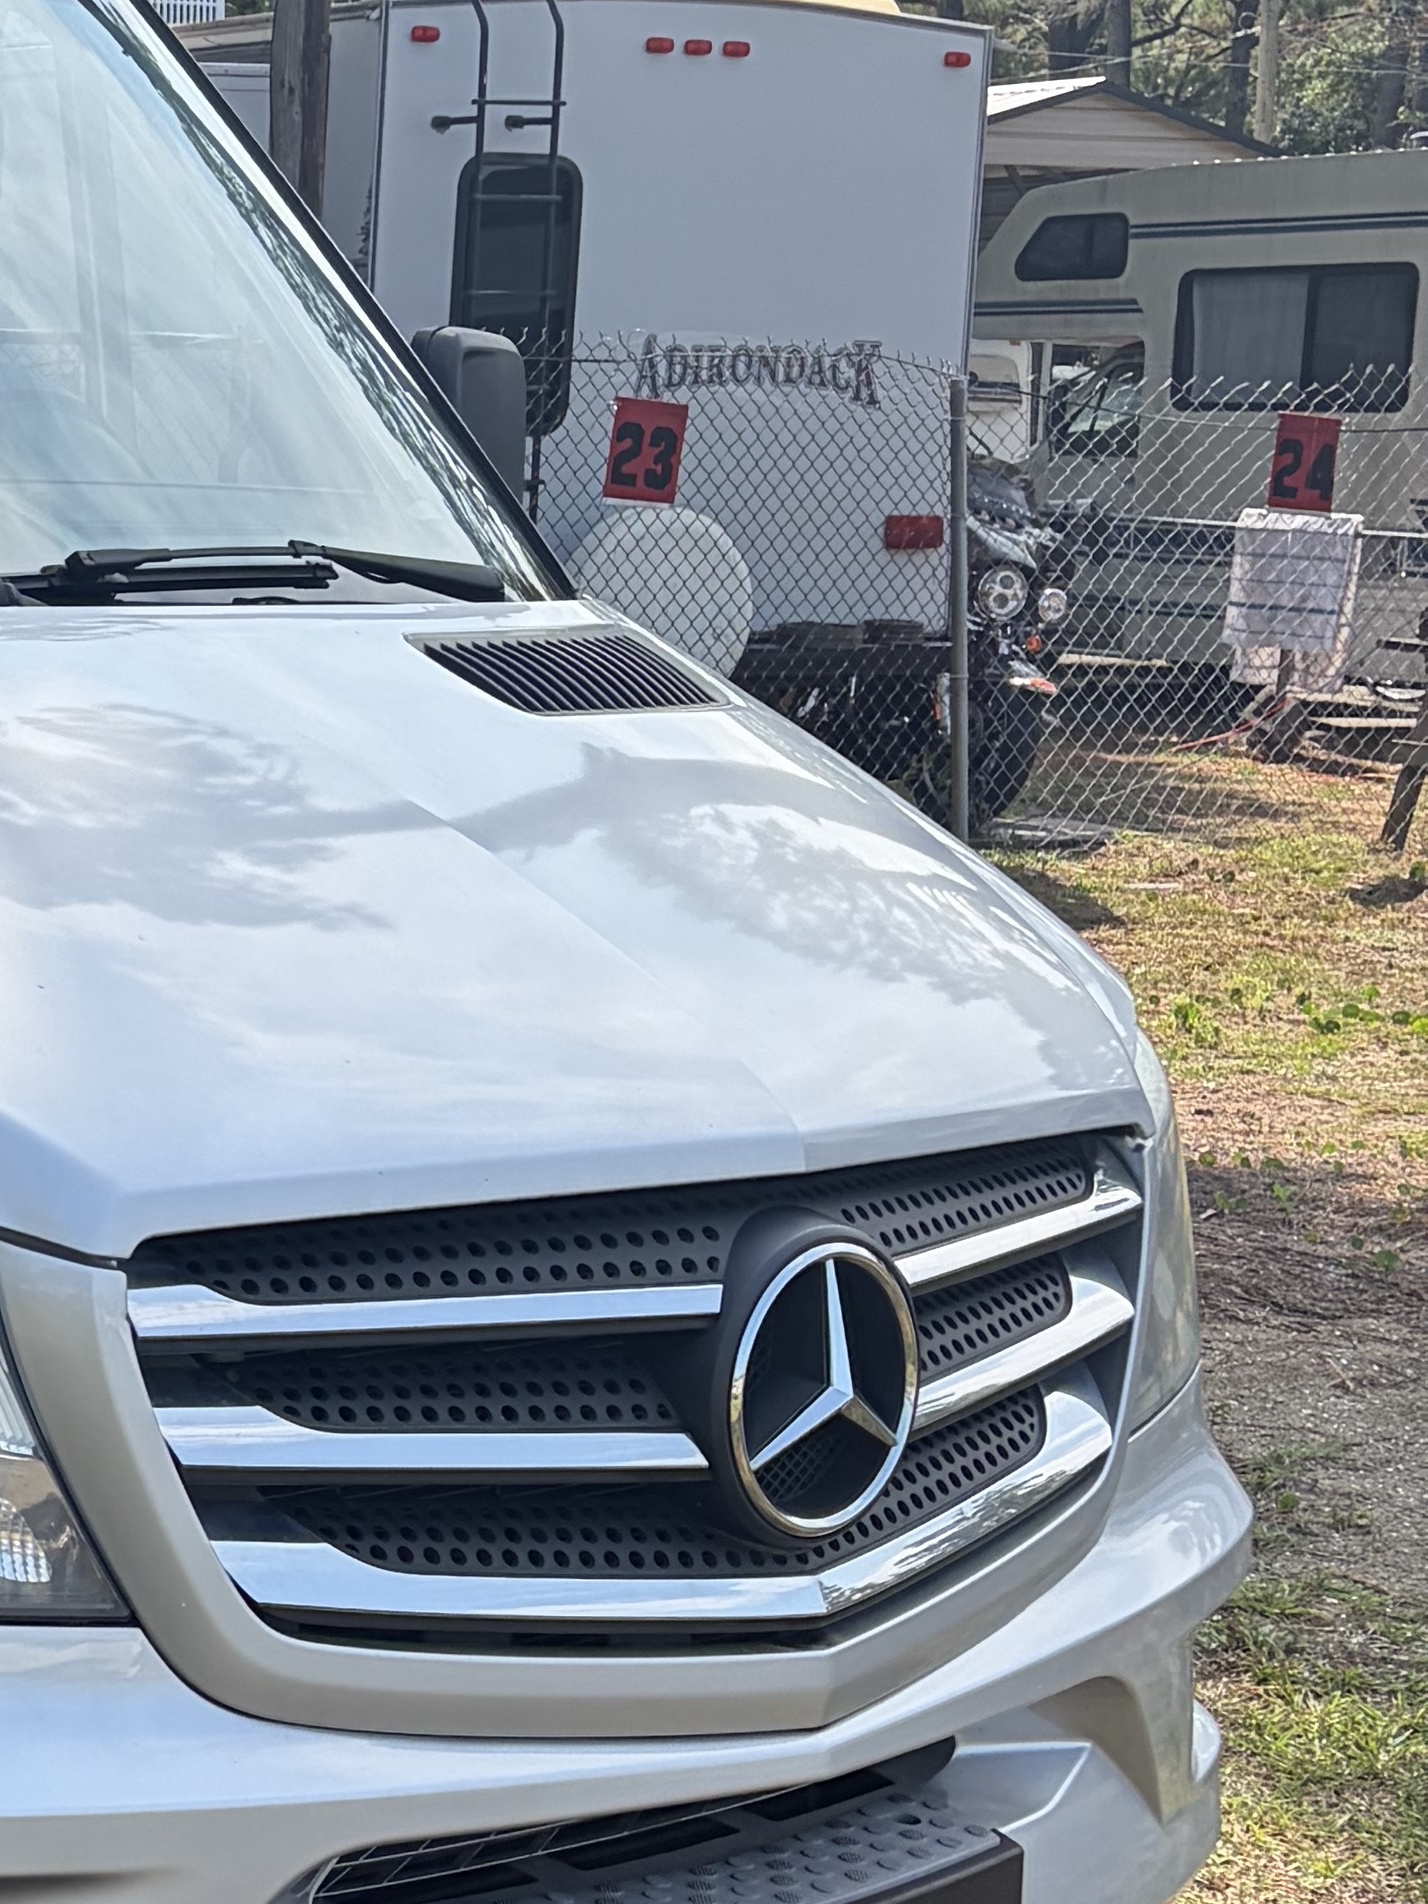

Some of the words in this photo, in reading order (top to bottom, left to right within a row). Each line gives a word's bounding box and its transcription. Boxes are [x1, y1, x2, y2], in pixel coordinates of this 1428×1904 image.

[634, 333, 882, 409] ADIRONDACK
[610, 422, 678, 490] 23
[1272, 438, 1334, 501] 24
